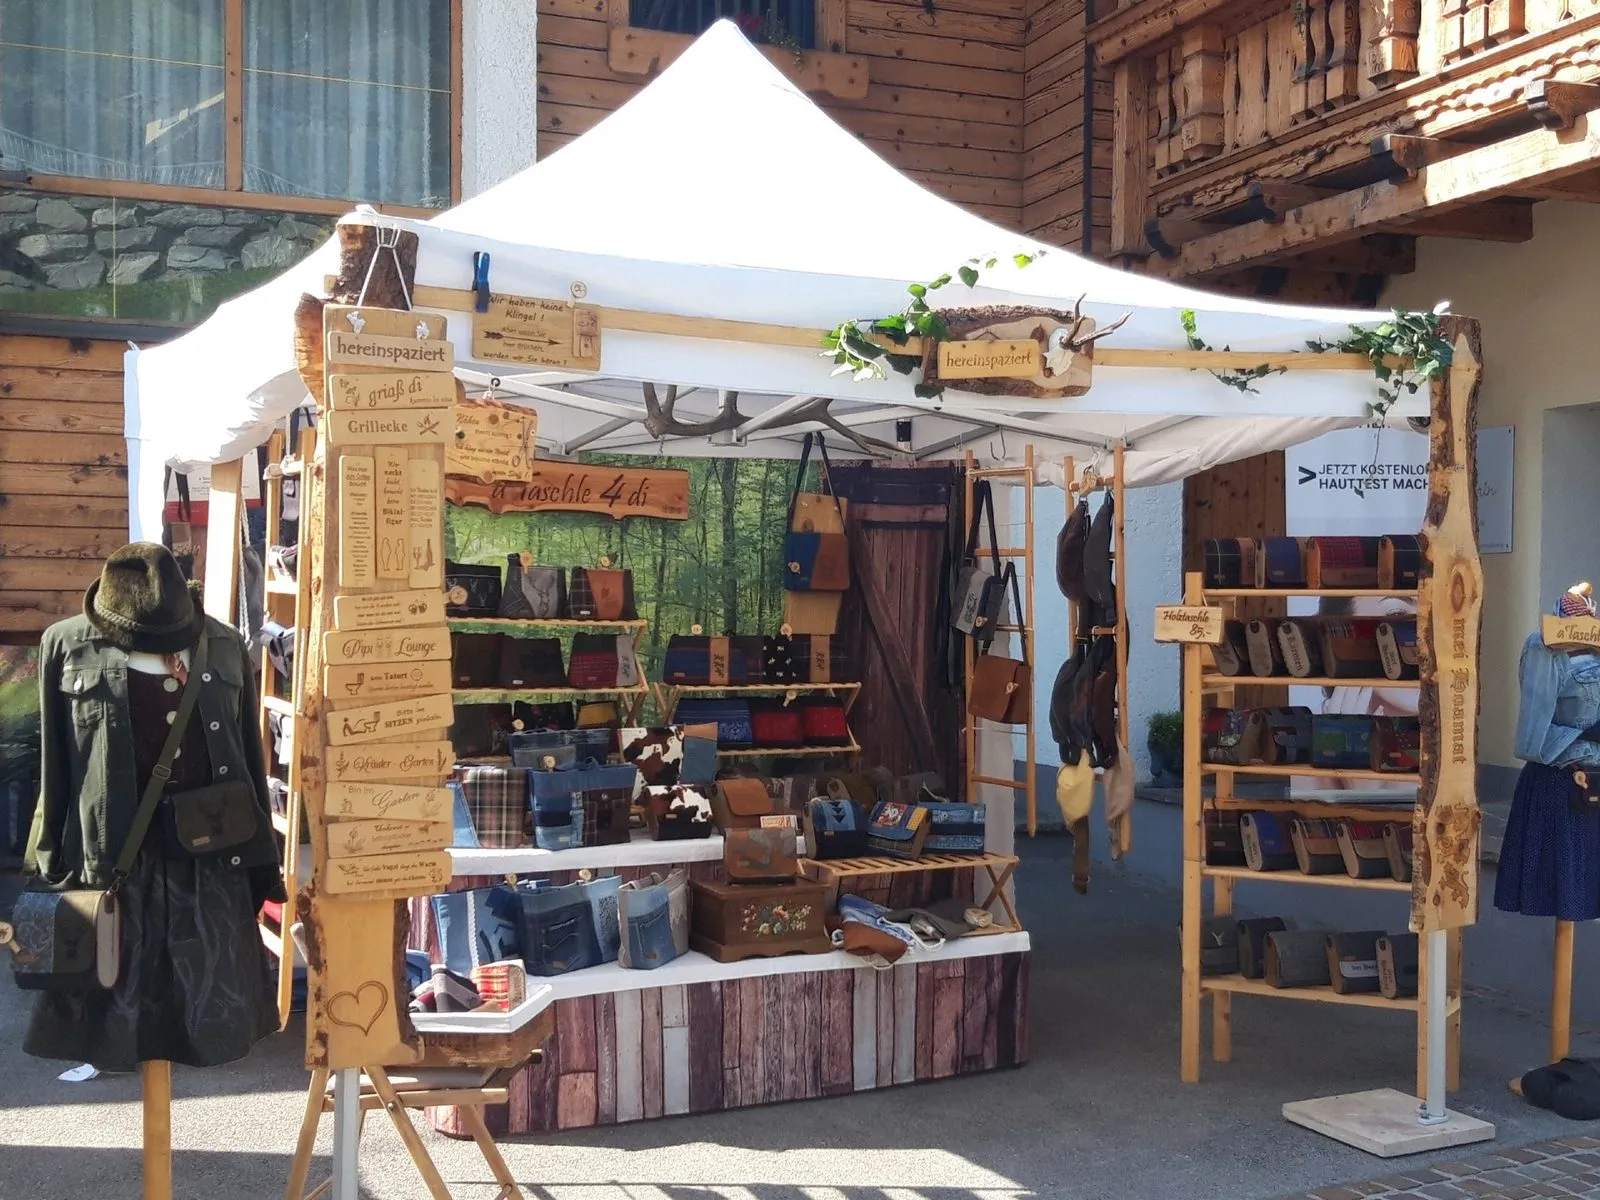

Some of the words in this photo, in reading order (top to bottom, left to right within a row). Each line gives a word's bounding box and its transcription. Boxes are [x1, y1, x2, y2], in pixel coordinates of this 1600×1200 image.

[508, 296, 536, 309] haben
[540, 300, 563, 312] keine
[505, 309, 536, 323] Klingel
[337, 336, 446, 363] hereinspaziert
[483, 351, 510, 359] werden
[946, 351, 1032, 370] hereinspaziert
[368, 379, 404, 408] griaß
[408, 375, 422, 394] di
[347, 419, 408, 433] Grillecke
[1319, 464, 1357, 475] JETZT
[600, 474, 627, 508] 4
[627, 477, 650, 507] di
[1319, 478, 1389, 490] HAUTTEST
[1163, 609, 1210, 623] Holztaschle
[1189, 623, 1212, 639] 85,-
[1452, 617, 1468, 659] mei
[342, 638, 373, 659] Pipi
[394, 636, 437, 657] Lounge
[383, 672, 408, 681] Tatort
[353, 756, 392, 773] Kräuter
[399, 754, 435, 772] Garten
[348, 786, 362, 794] Bin
[372, 789, 421, 817] Garten
